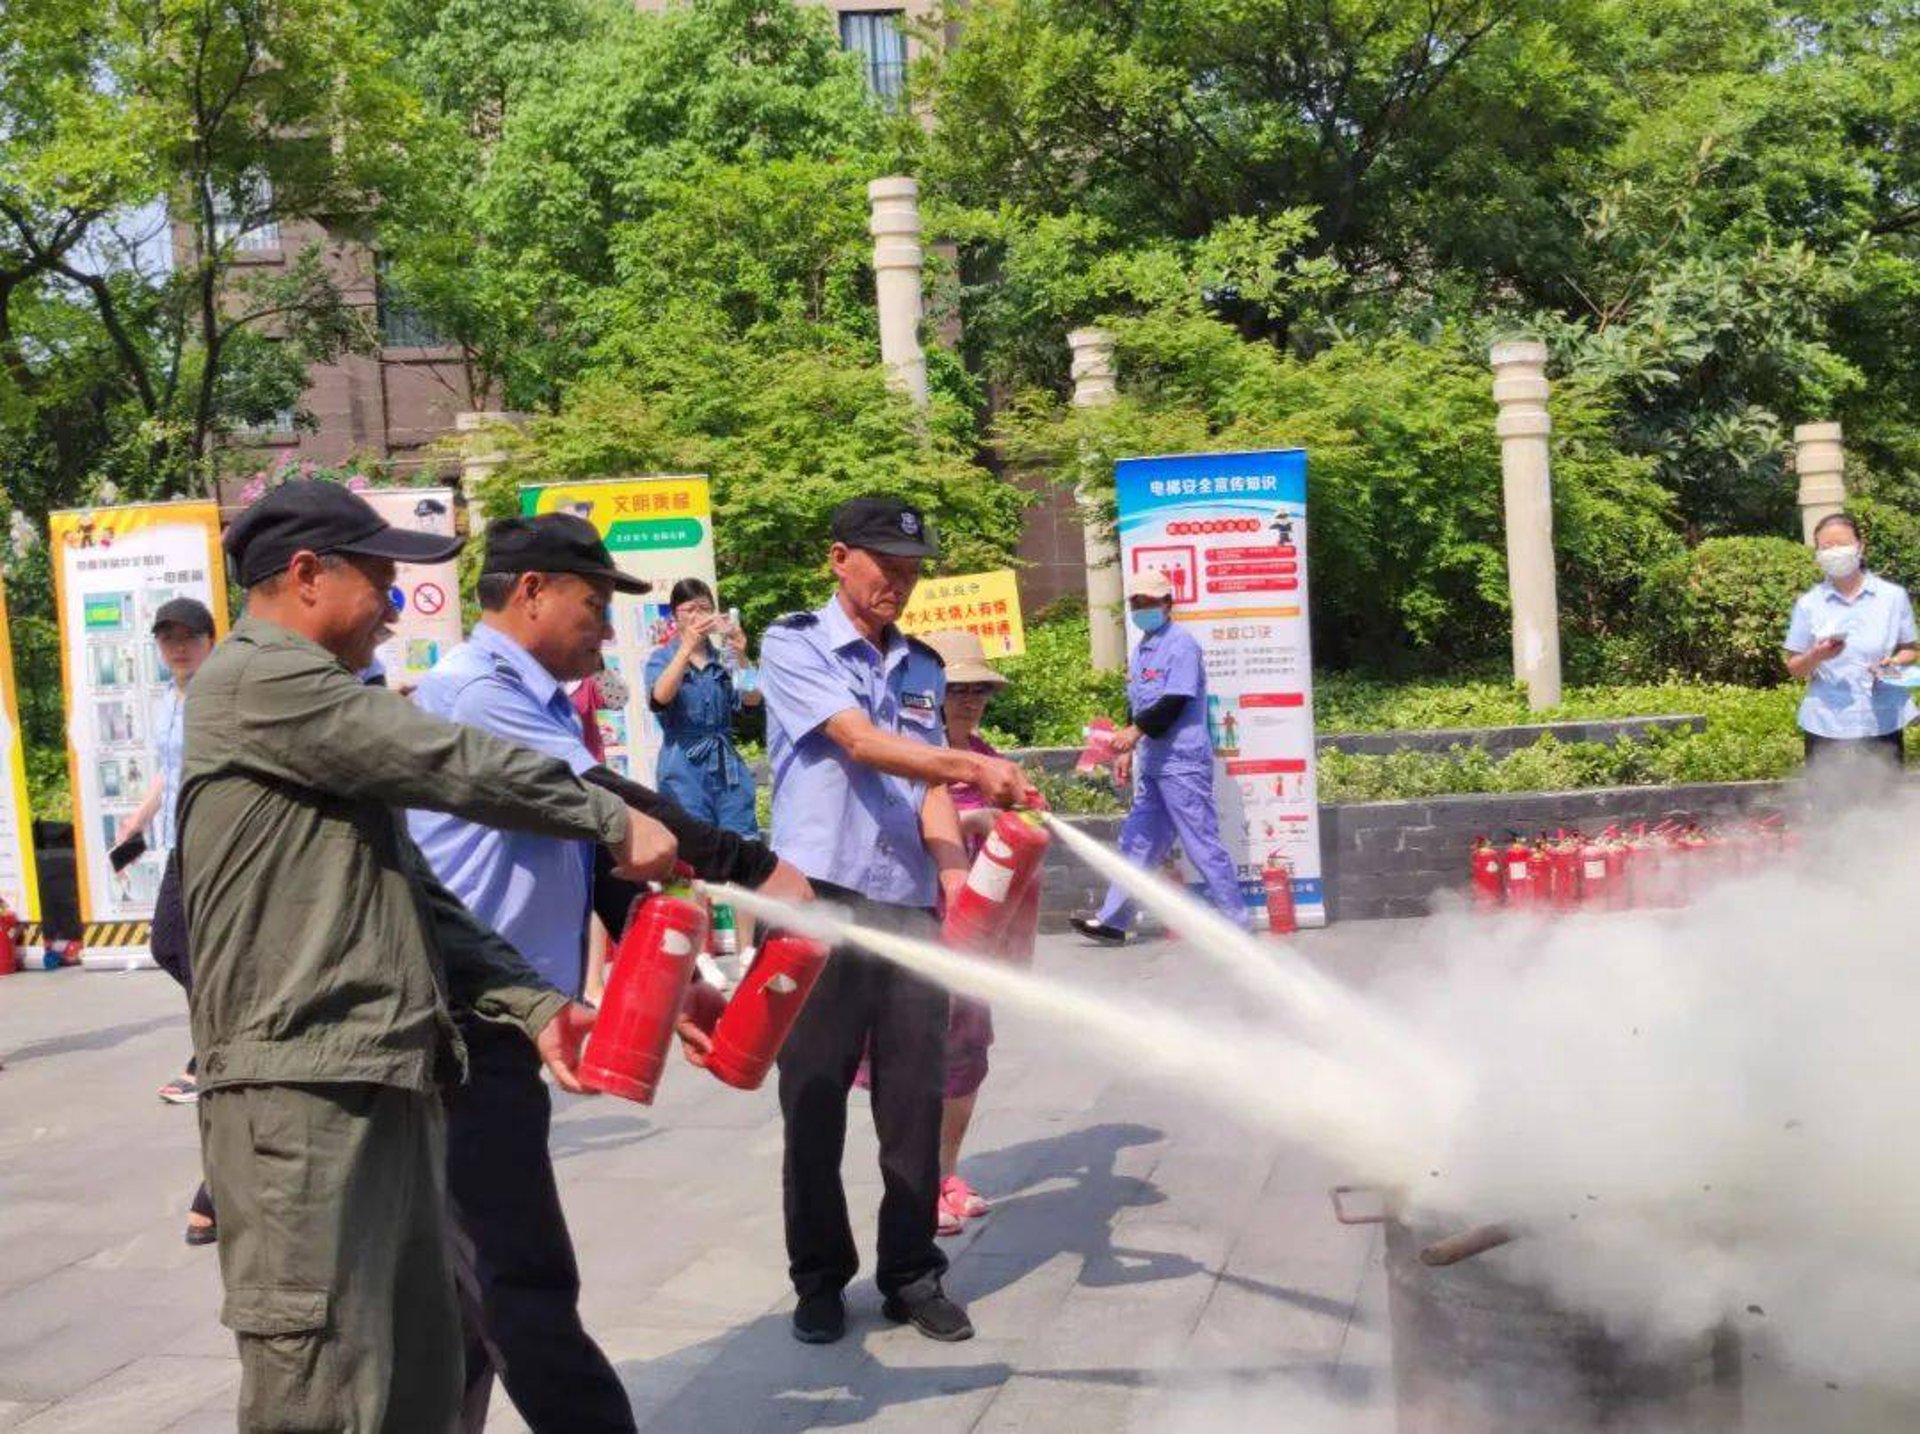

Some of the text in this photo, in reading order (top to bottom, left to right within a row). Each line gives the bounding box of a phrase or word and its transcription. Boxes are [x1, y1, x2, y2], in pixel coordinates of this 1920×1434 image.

[1150, 475, 1278, 496] 电梯安全宣传知识
